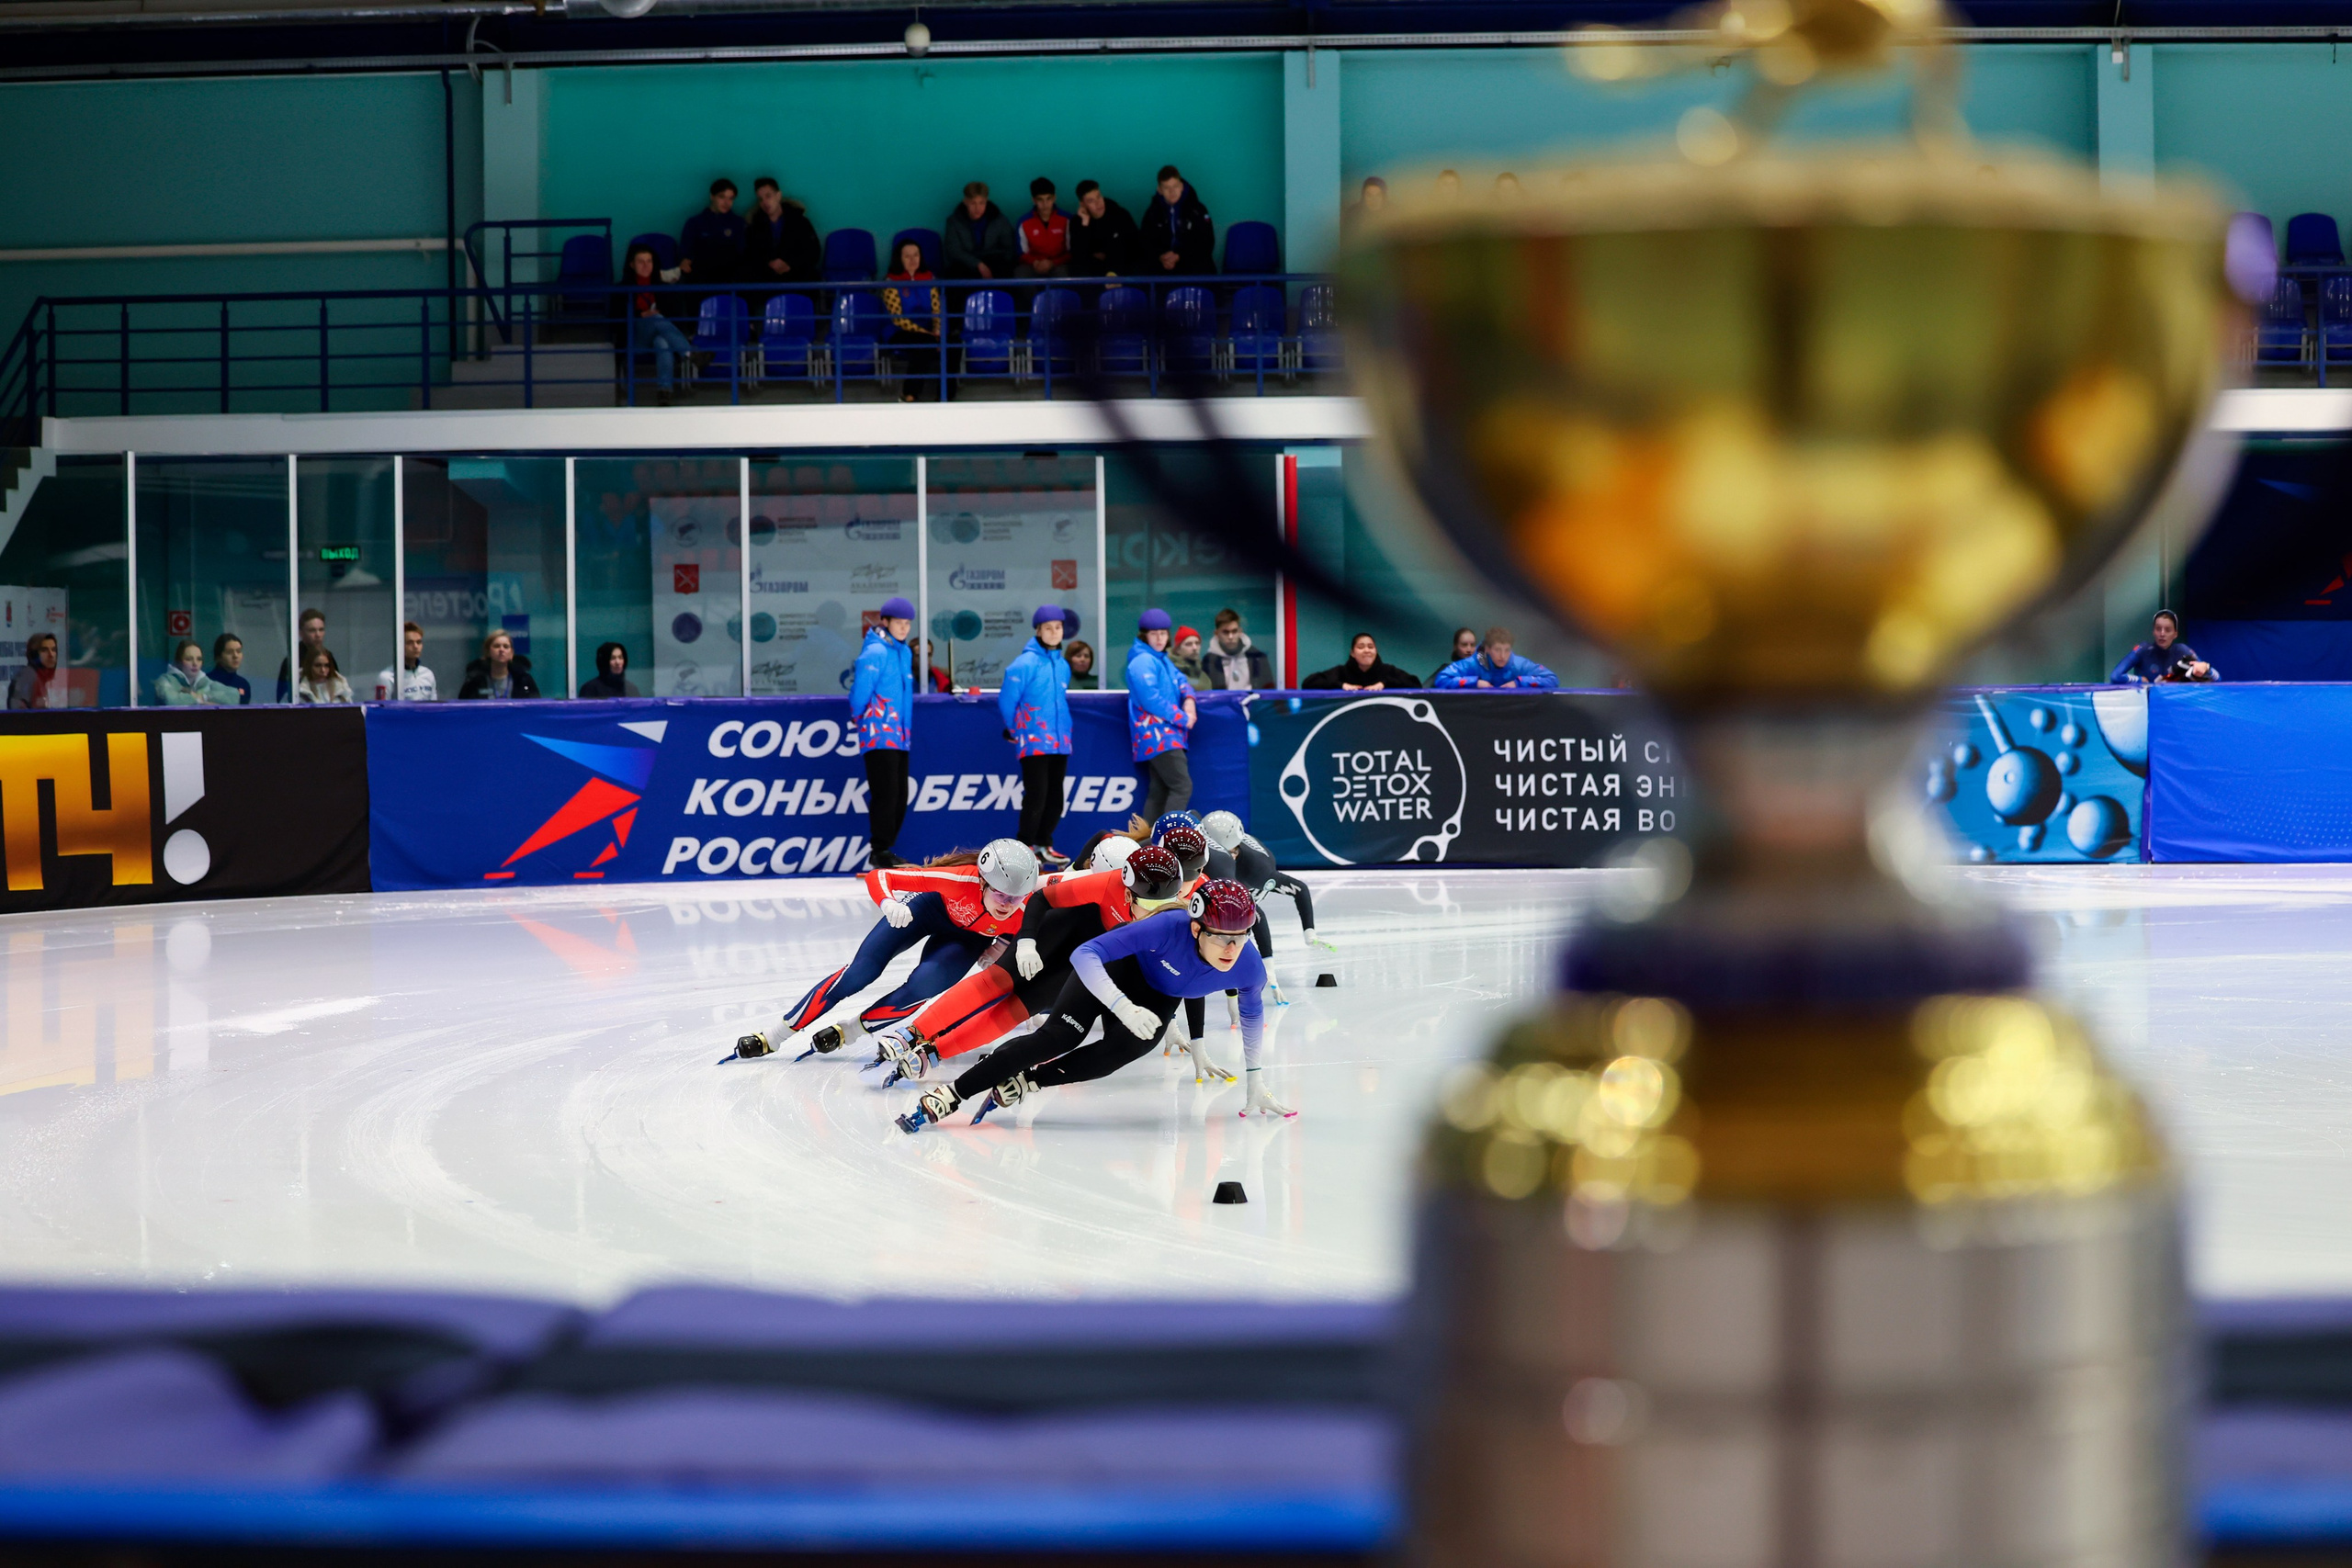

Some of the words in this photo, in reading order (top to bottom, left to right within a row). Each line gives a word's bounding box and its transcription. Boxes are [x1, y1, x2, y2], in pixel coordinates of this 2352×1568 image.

[322, 547, 359, 560] ВЫХОД
[707, 719, 861, 759] СОЮЗ
[1494, 733, 1627, 763] ЧИСТЫЙ
[1332, 749, 1431, 774] TOTAL
[684, 773, 1138, 818] КОНЬКБЕЖЕВ
[1332, 773, 1431, 798] DETOX
[1495, 773, 1621, 797] ЧИСТАЯ
[1332, 797, 1433, 823] WATER
[1495, 807, 1621, 831] ЧИСТАЯ
[662, 835, 874, 875] РОССИИ
[980, 852, 989, 865] 6
[1123, 865, 1128, 880] 8
[1060, 1013, 1085, 1033] K4SPEED
